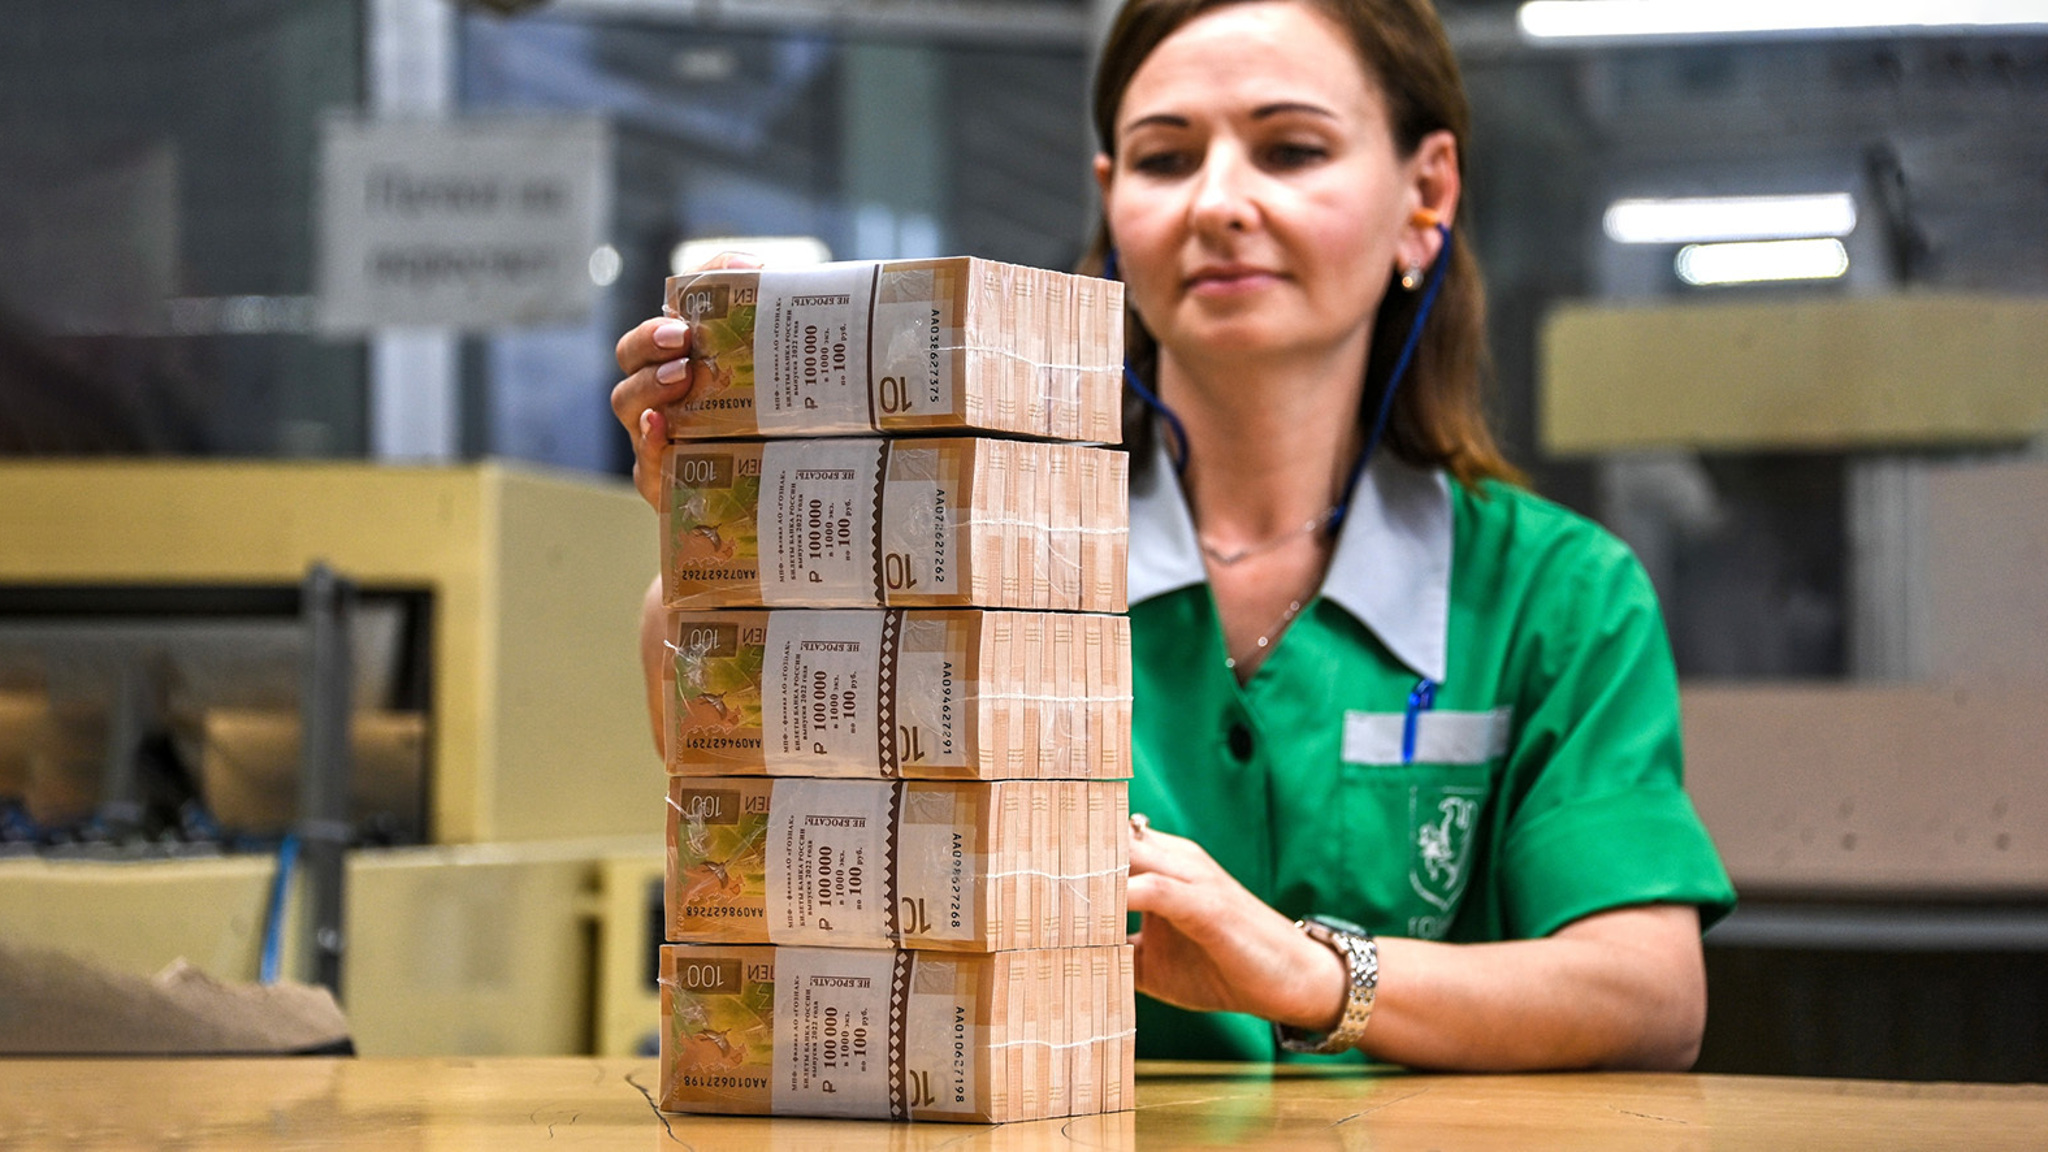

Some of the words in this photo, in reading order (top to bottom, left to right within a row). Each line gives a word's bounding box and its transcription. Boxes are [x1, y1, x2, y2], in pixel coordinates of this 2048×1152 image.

[686, 291, 713, 314] 100
[774, 341, 779, 351] АО
[805, 325, 817, 354] 000
[821, 347, 829, 373] 1000
[833, 343, 845, 371] 100
[930, 309, 940, 403] AA038627375
[805, 357, 817, 385] 100
[685, 460, 716, 482] 100
[778, 513, 783, 523] АО
[809, 500, 822, 528] 000
[809, 531, 821, 559] 100
[825, 522, 833, 548] 1000
[837, 518, 850, 546] 100
[682, 569, 756, 580] AA072627262
[691, 629, 720, 651] 100
[782, 684, 787, 695] АО
[814, 671, 827, 699] 000
[814, 703, 826, 730] 100
[830, 694, 838, 720] 1000
[843, 691, 856, 718] 100
[687, 738, 761, 749] AA094627291
[692, 795, 722, 817] 100
[853, 819, 865, 827] НЕ
[787, 858, 791, 869] АО
[819, 846, 832, 875] 000
[819, 879, 831, 907] 100
[836, 870, 844, 896] 1000
[849, 867, 862, 895] 100
[686, 906, 764, 918] AA098627268
[687, 964, 724, 988] 100
[857, 978, 870, 988] НЕ
[793, 1019, 798, 1030] АО
[824, 1007, 837, 1036] 000
[824, 1040, 837, 1069] 100
[841, 1031, 849, 1057] 1000
[854, 1028, 866, 1057] 100
[954, 1006, 965, 1103] AA010627198
[684, 1076, 768, 1089] AA010627198
